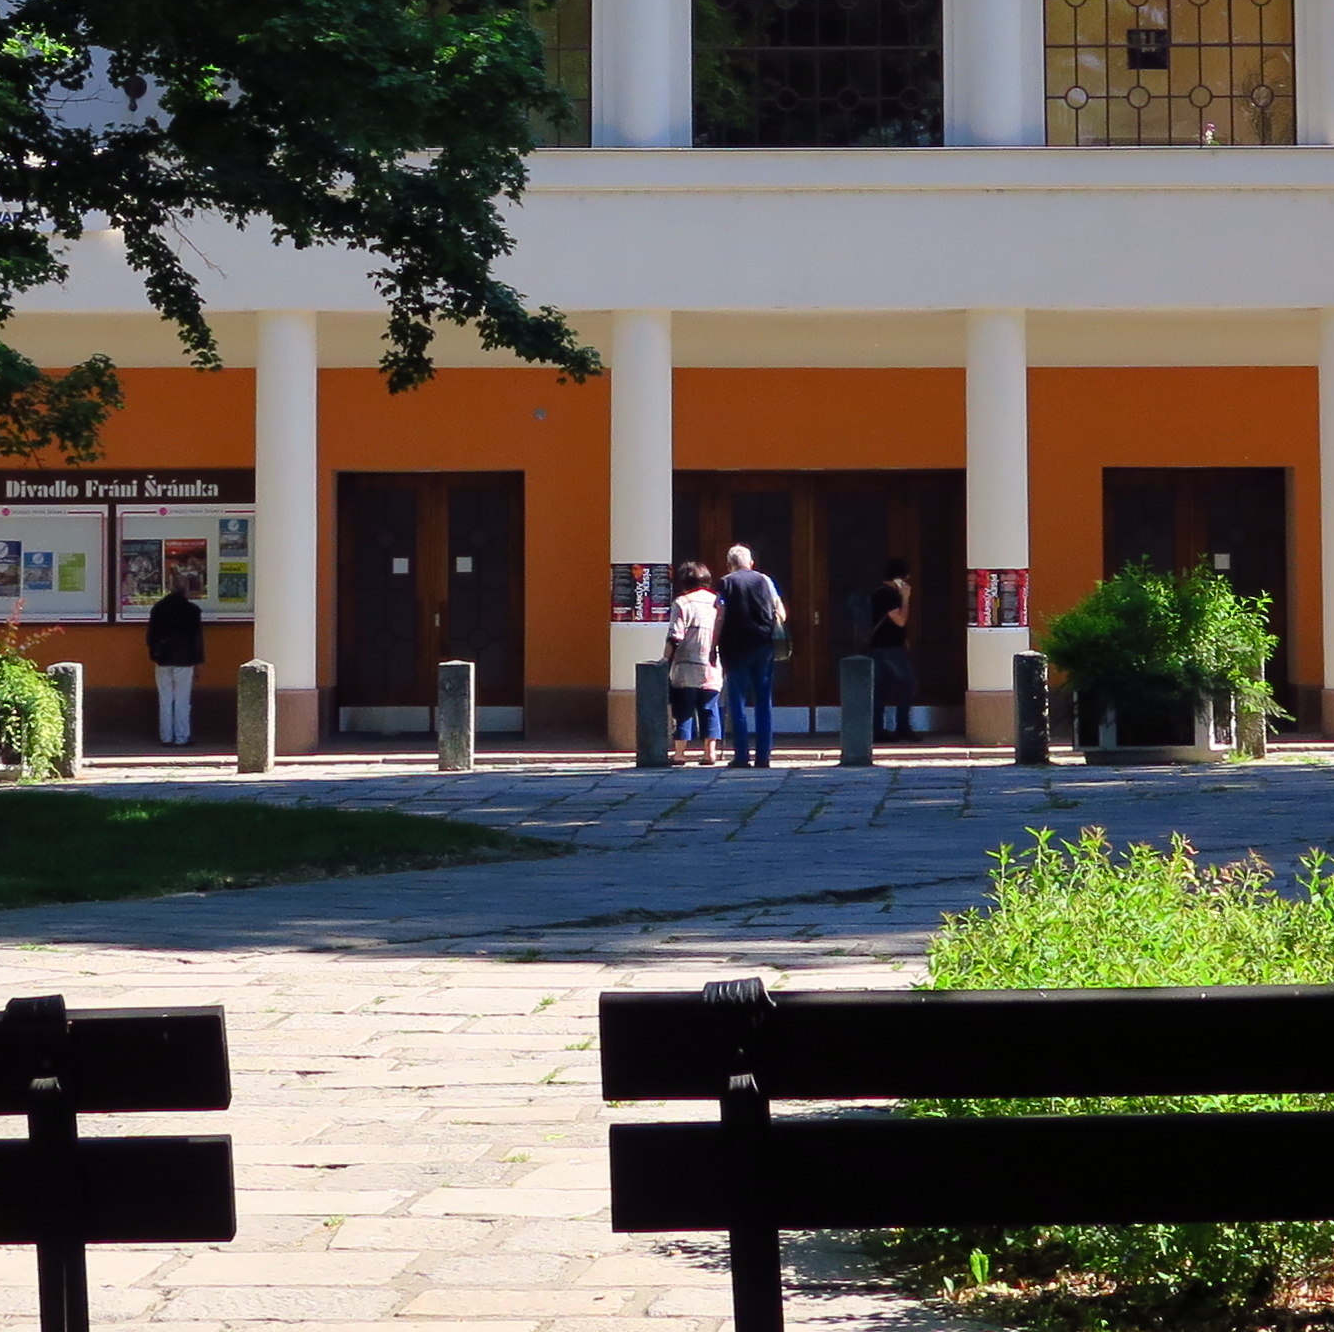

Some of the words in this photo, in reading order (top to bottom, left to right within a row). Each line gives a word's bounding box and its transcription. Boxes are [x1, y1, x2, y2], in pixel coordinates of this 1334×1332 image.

[5, 479, 79, 498] Divadlo
[85, 479, 138, 497] Fráni
[144, 474, 219, 497] Šrámka
